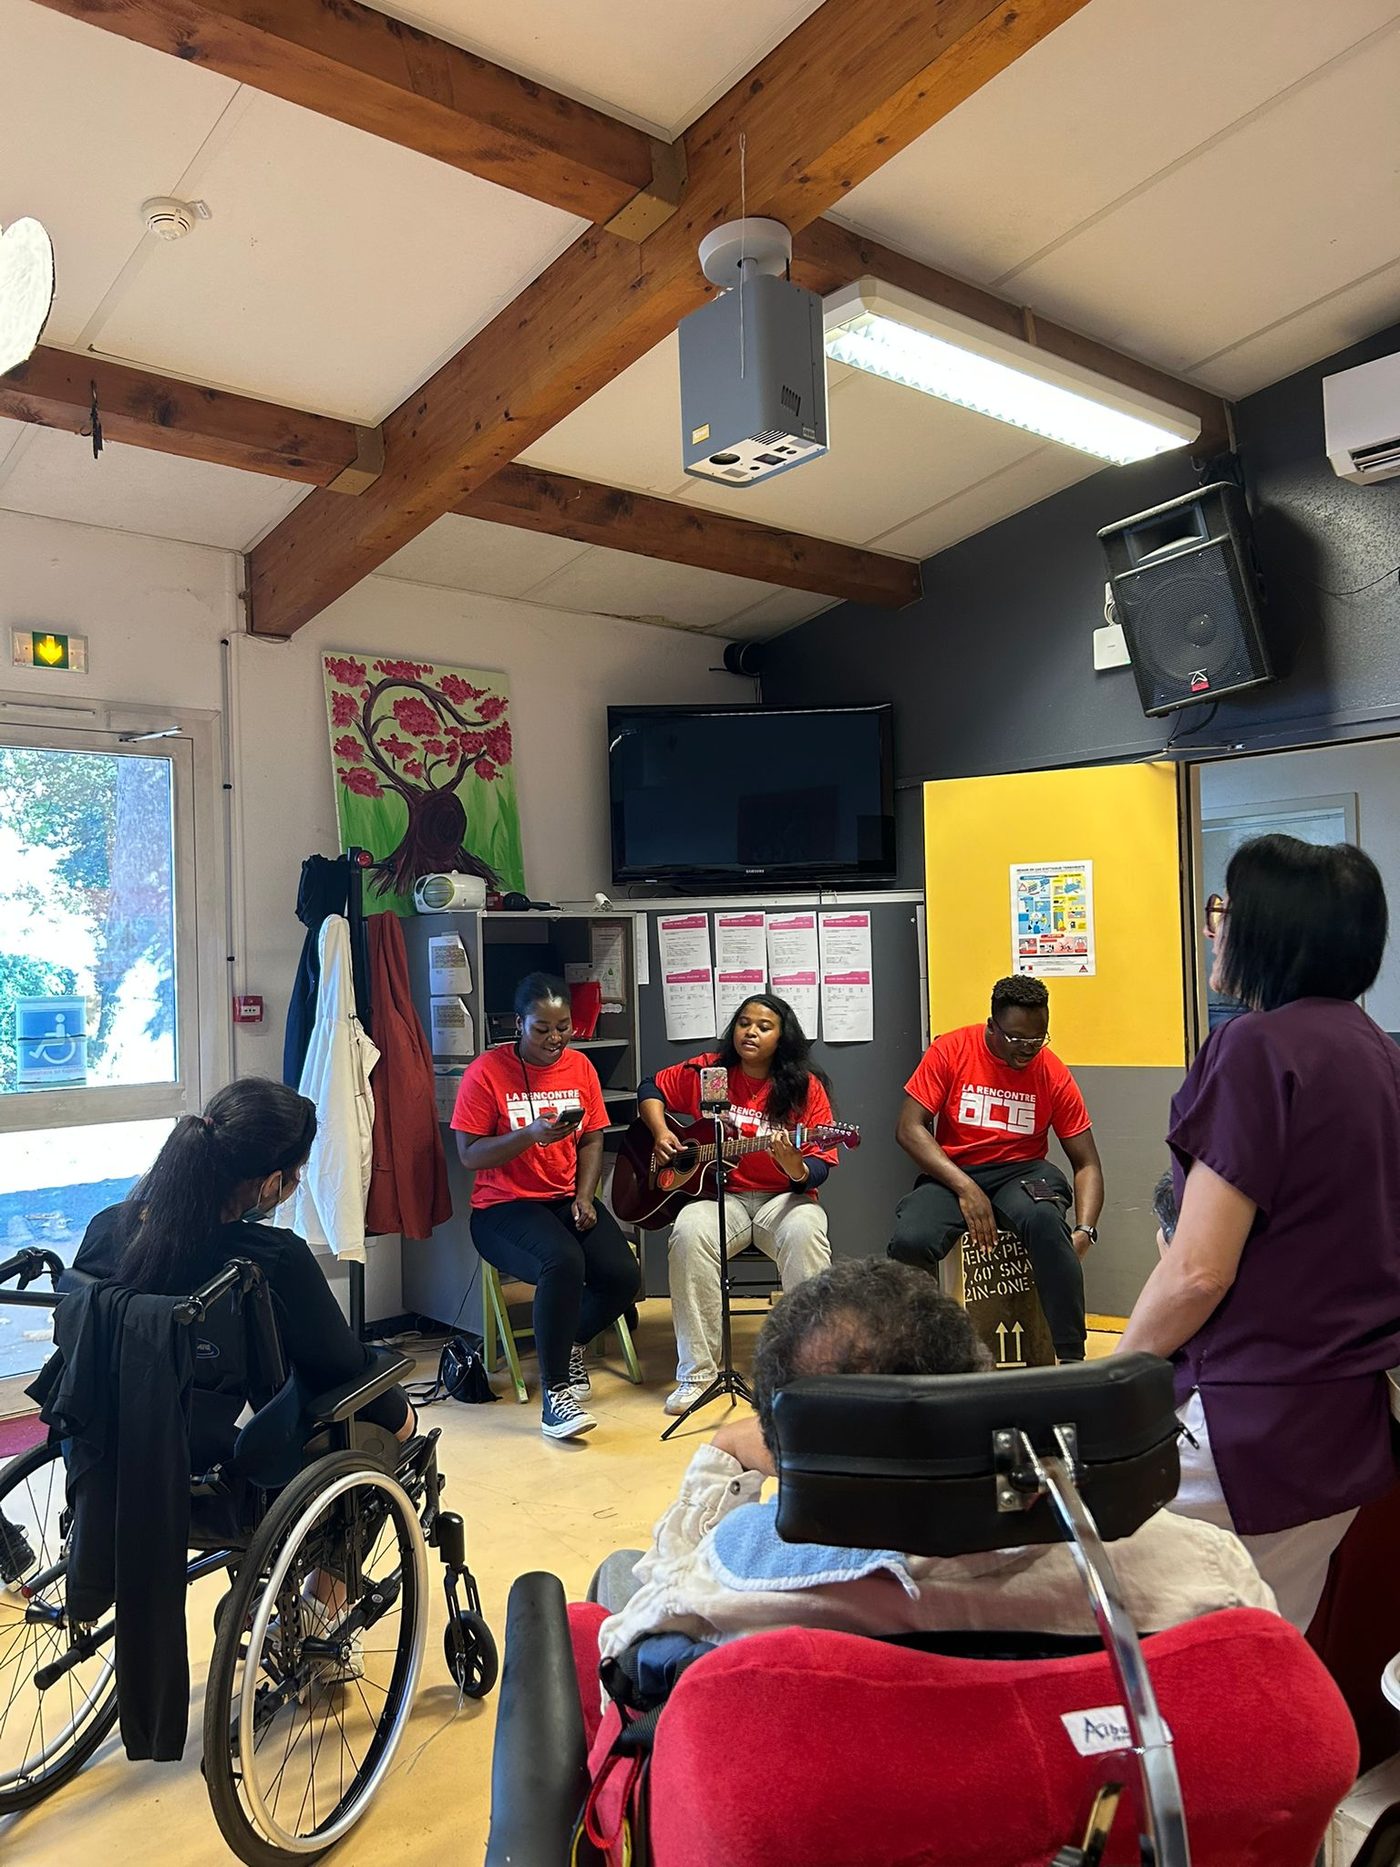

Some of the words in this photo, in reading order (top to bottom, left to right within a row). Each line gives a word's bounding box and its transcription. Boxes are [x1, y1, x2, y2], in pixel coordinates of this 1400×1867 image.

[506, 1093, 520, 1102] LA
[962, 1083, 974, 1093] LA
[976, 1085, 1037, 1103] RENCONTRE
